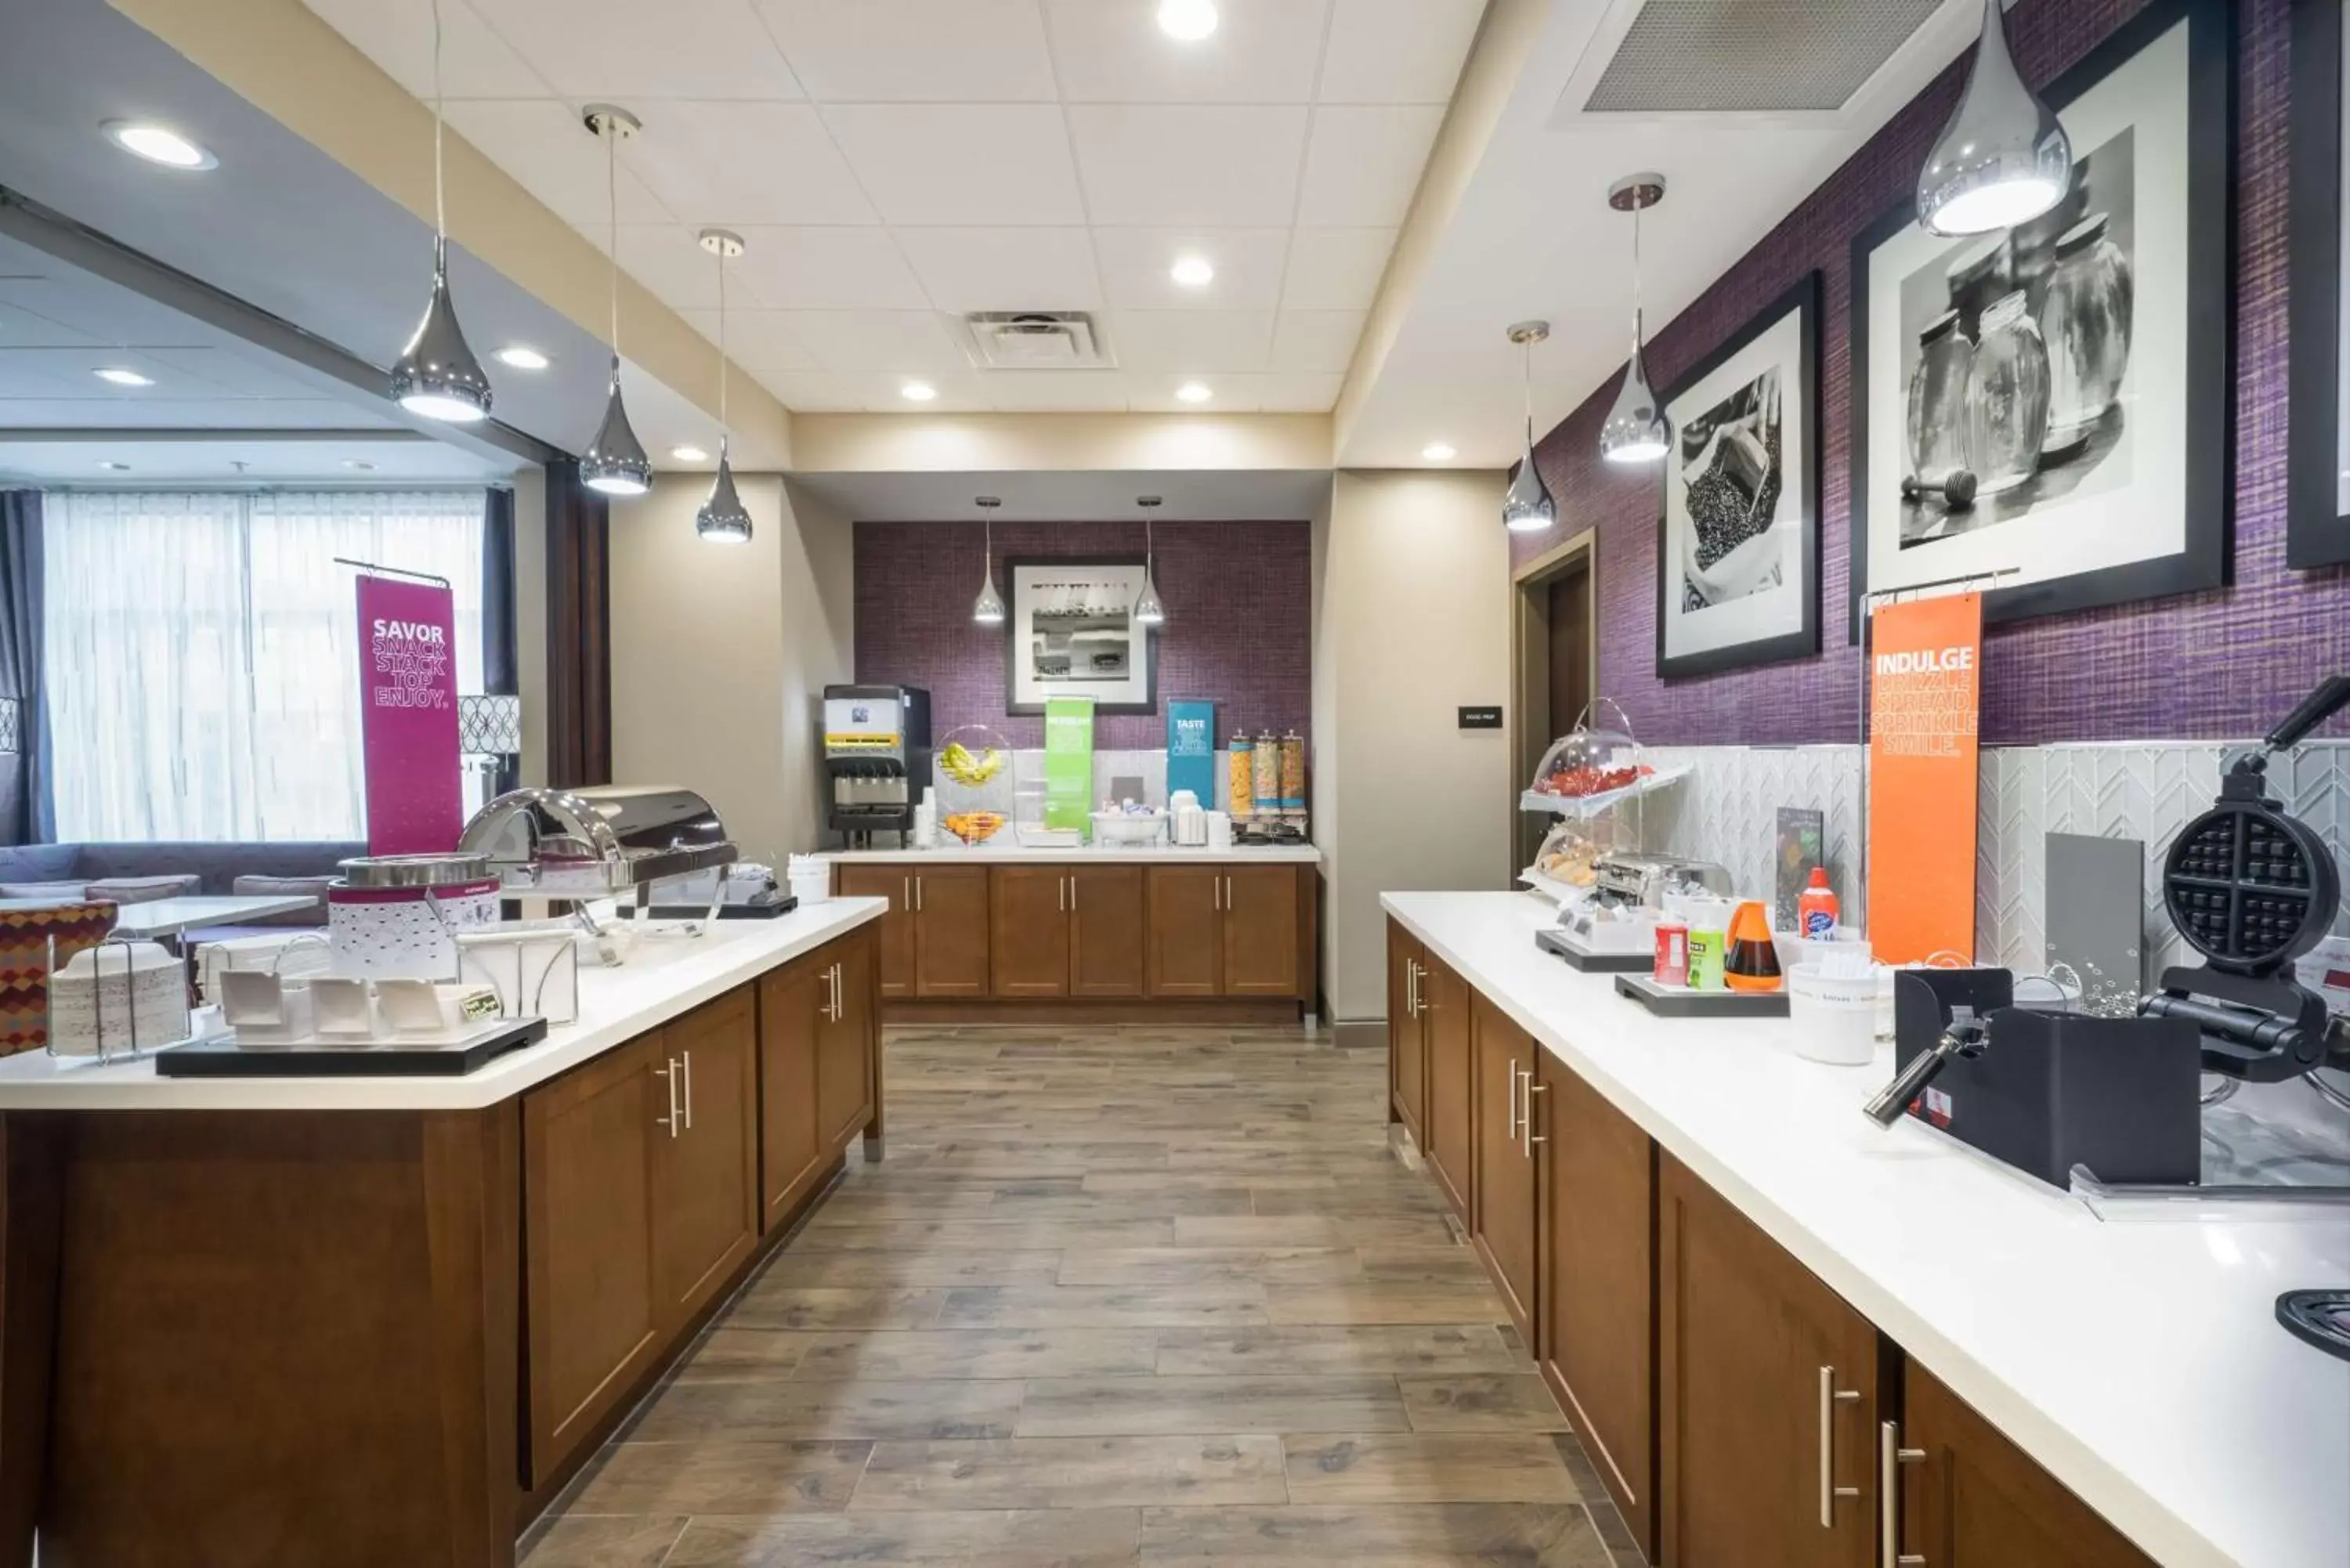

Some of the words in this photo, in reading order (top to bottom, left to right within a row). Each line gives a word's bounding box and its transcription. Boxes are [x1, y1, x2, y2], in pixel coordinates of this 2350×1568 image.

[373, 619, 446, 644] SAVOR
[372, 635, 446, 661] SNACK
[376, 653, 446, 676] STACK
[1876, 646, 1974, 675] INDULGE
[391, 670, 433, 690] TOP
[1878, 670, 1972, 693] DRIZZLE
[1876, 691, 1971, 714] SPREAD
[1177, 719, 1206, 728] TASTE
[1871, 711, 1978, 735] SPRINKLE
